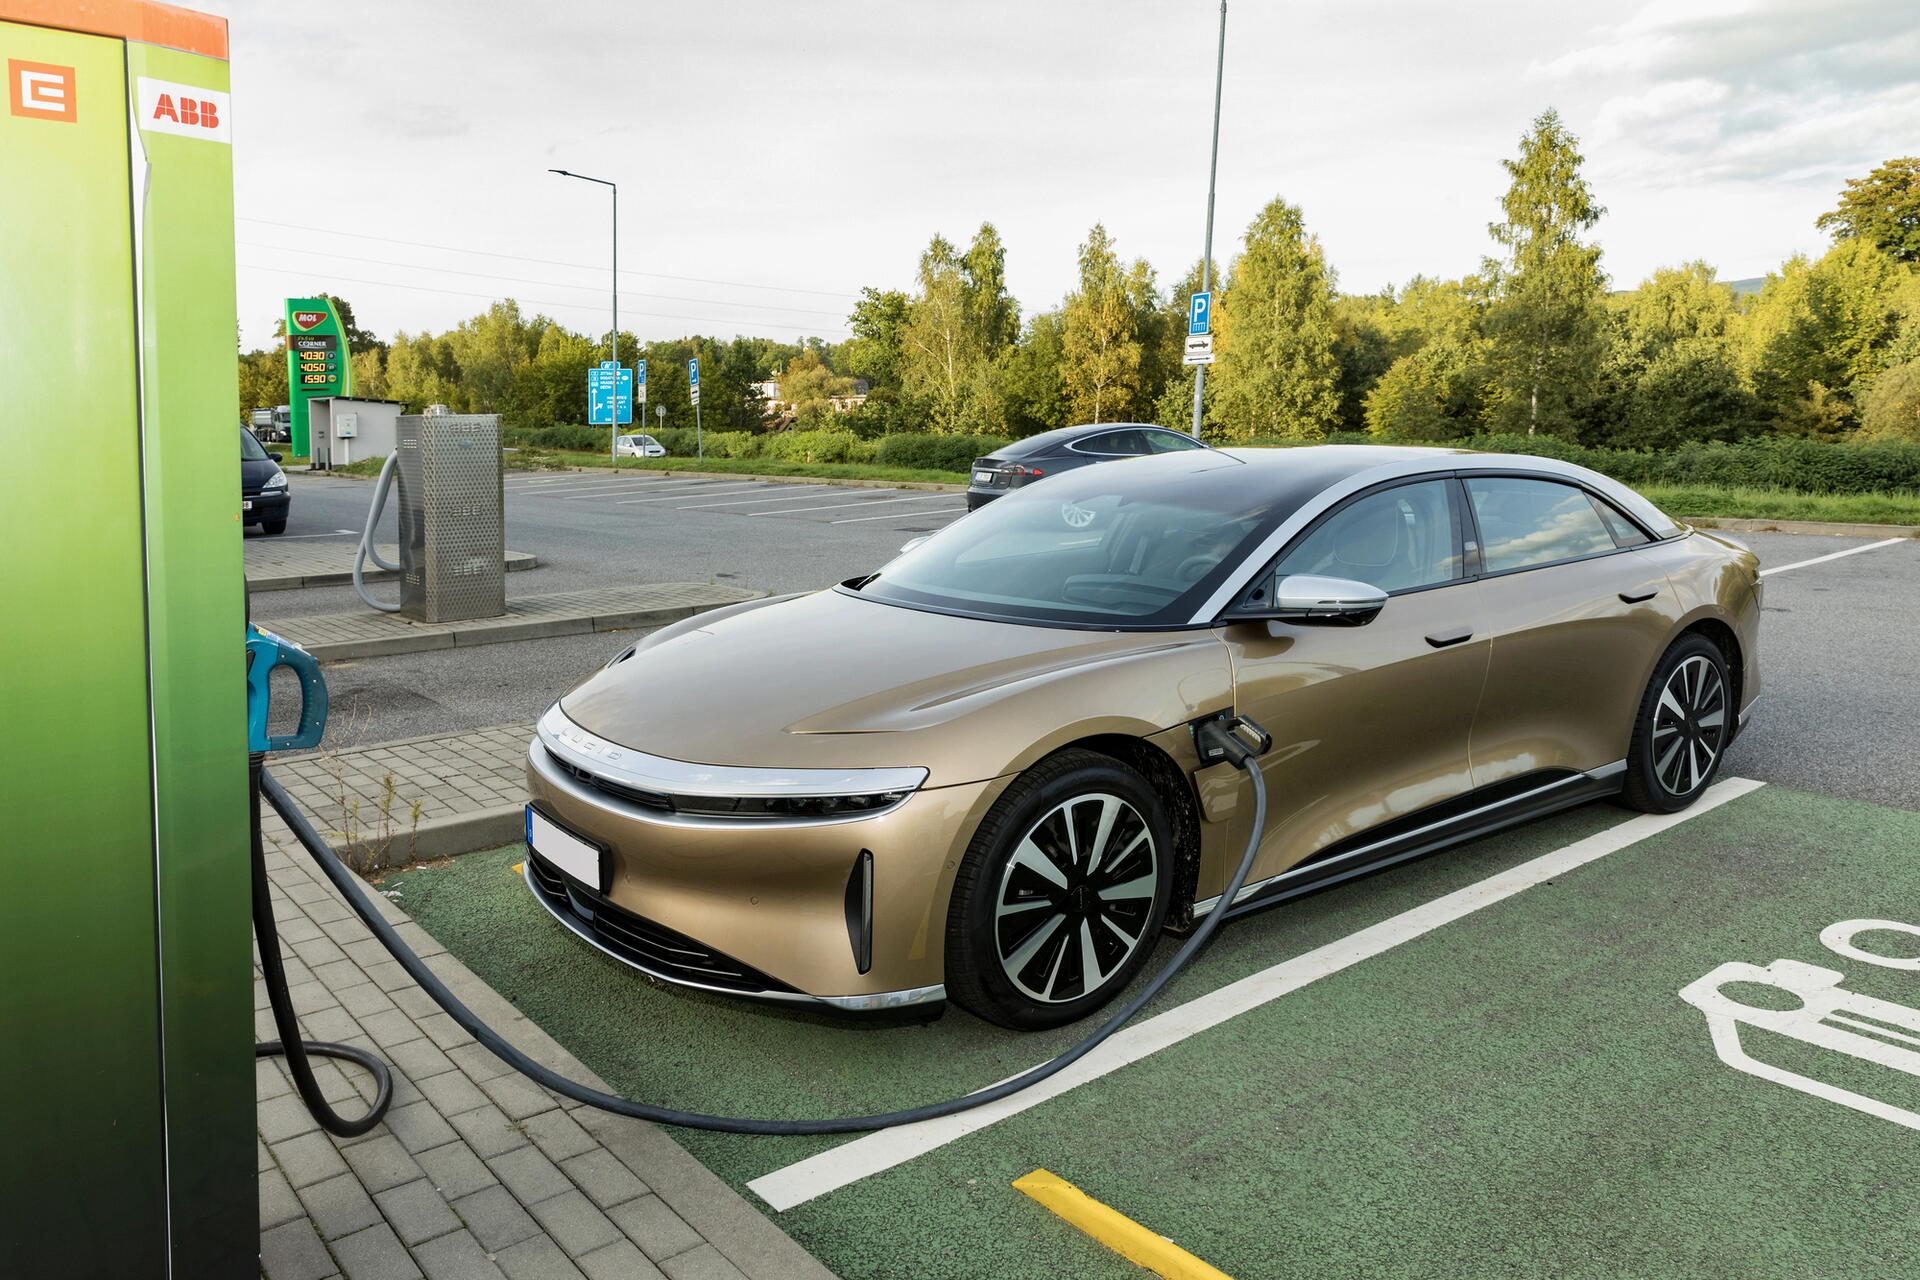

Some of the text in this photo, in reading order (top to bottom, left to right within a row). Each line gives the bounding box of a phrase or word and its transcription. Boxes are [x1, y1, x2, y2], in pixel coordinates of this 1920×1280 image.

[152, 93, 220, 129] ABB
[1194, 299, 1206, 322] P
[298, 314, 317, 322] MOL
[300, 351, 325, 360] 4030
[301, 363, 326, 372] 4050
[305, 374, 326, 383] 1590
[561, 727, 622, 760] LUCID
